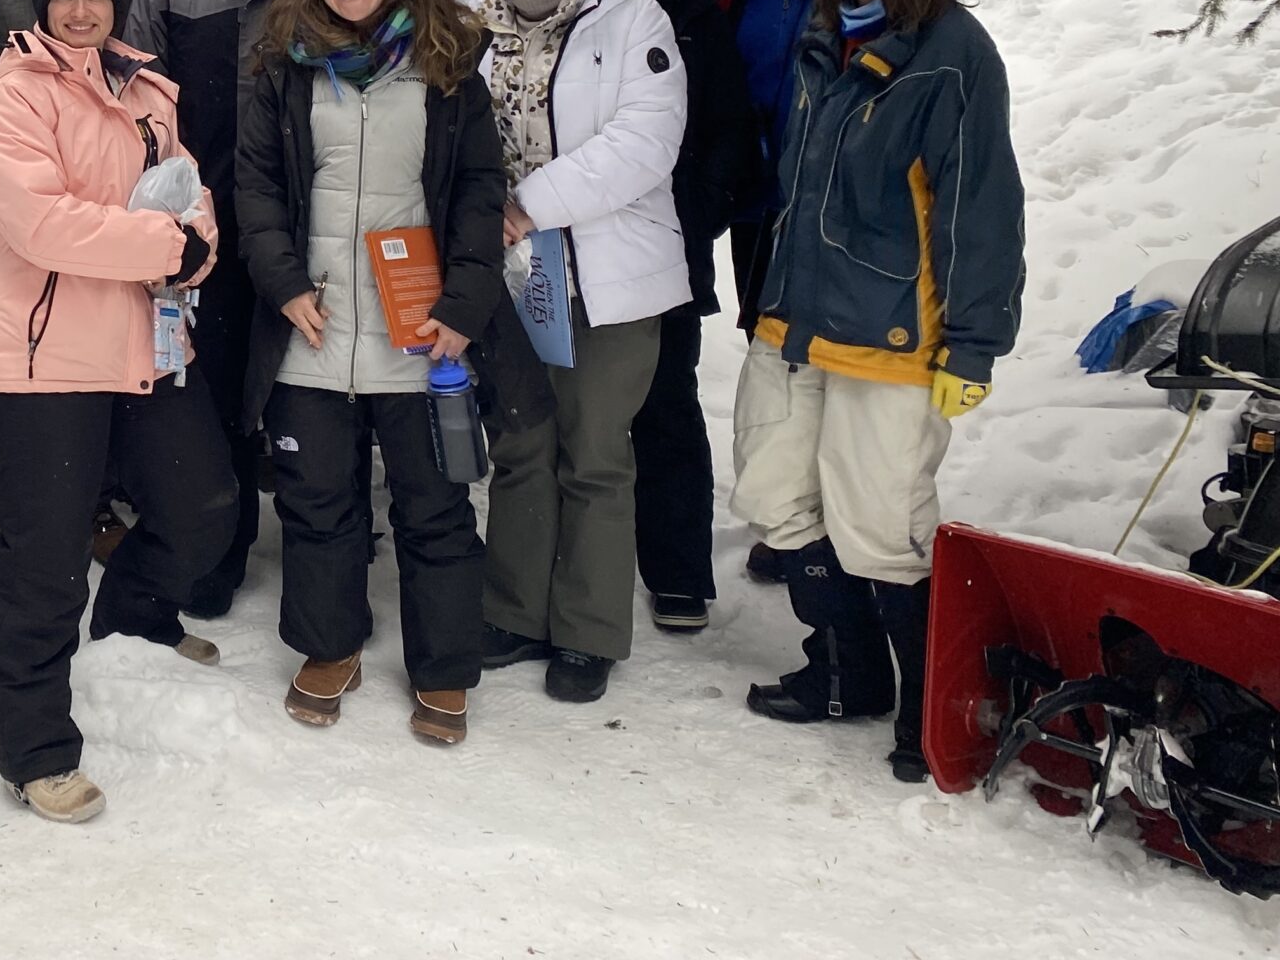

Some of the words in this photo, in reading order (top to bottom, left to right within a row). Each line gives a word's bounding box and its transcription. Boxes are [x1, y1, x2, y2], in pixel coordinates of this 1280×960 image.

[530, 255, 548, 330] WOLVES
[547, 303, 555, 322] THE
[805, 566, 829, 577] OR
